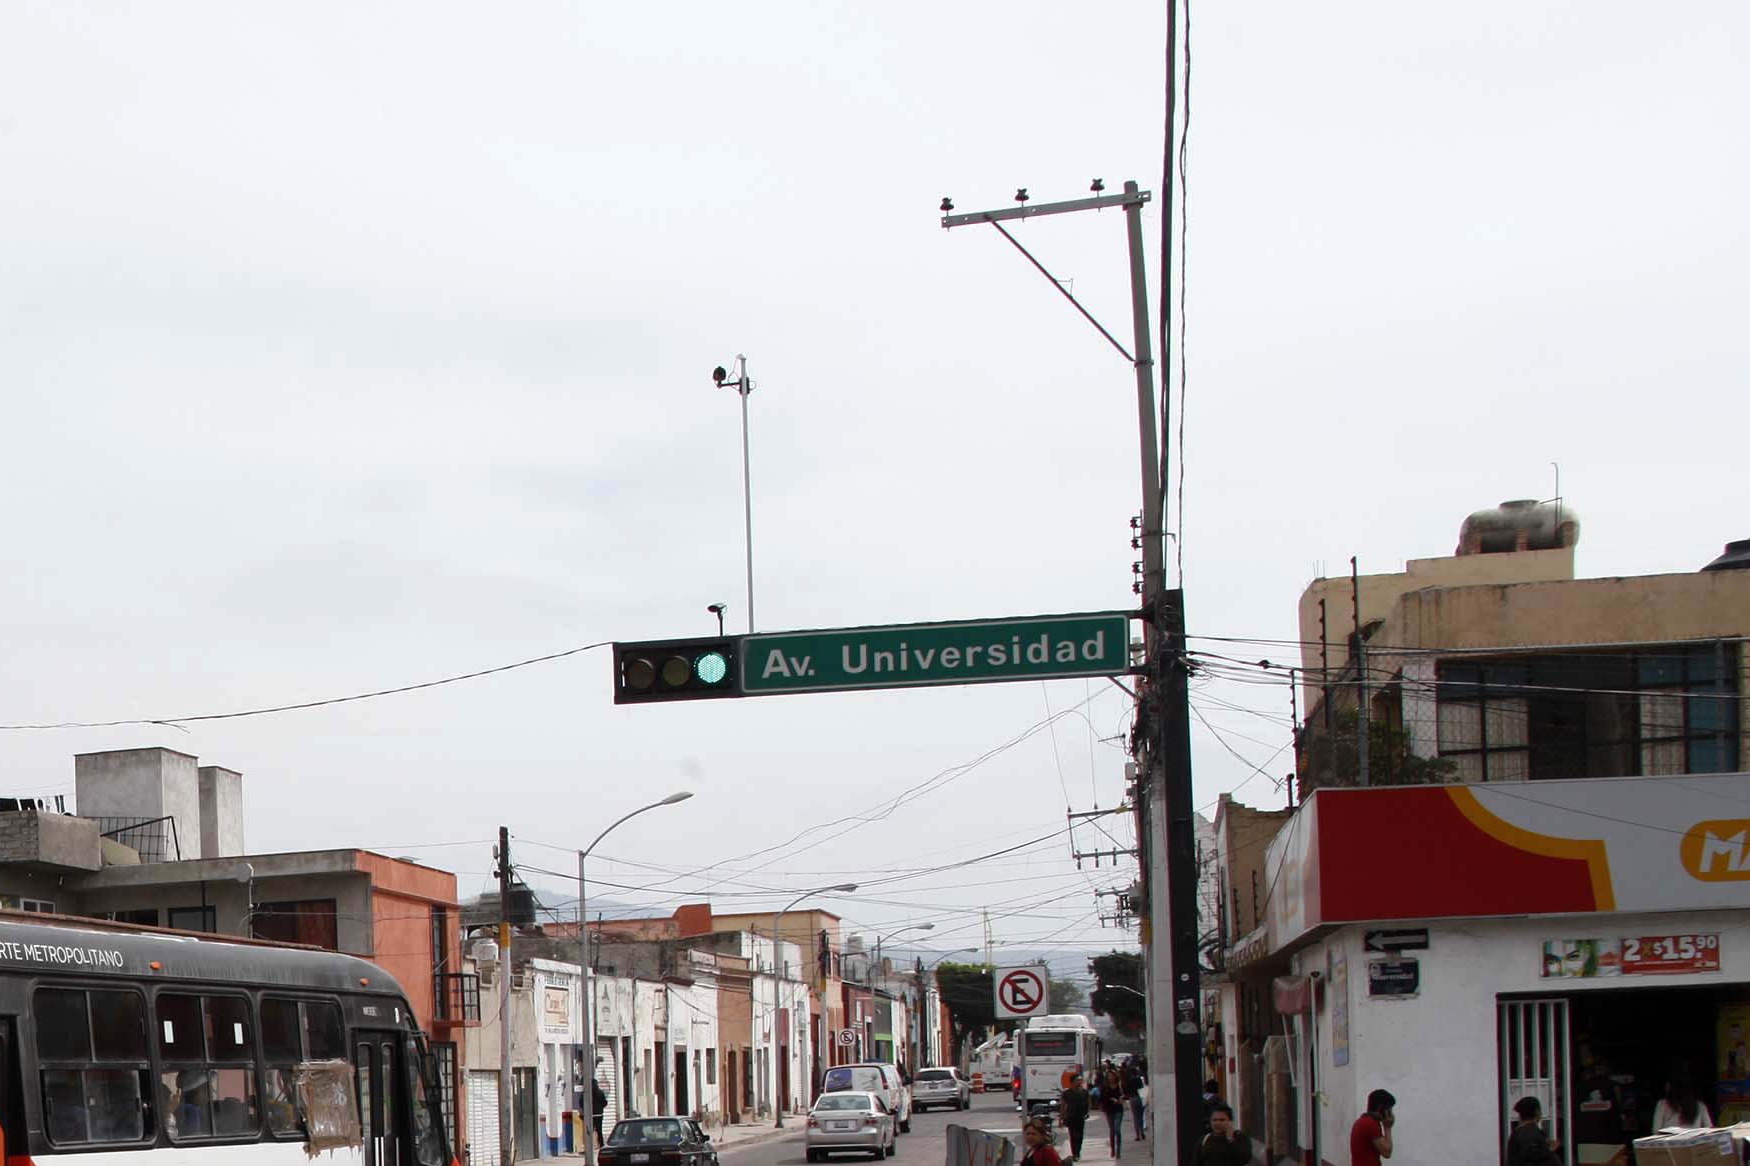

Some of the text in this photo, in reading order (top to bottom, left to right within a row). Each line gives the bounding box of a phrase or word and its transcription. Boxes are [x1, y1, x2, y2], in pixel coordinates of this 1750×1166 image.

[761, 630, 1106, 678] Av. Universidad
[23, 943, 124, 968] METROPOLITANO
[1624, 939, 1641, 961] 2
